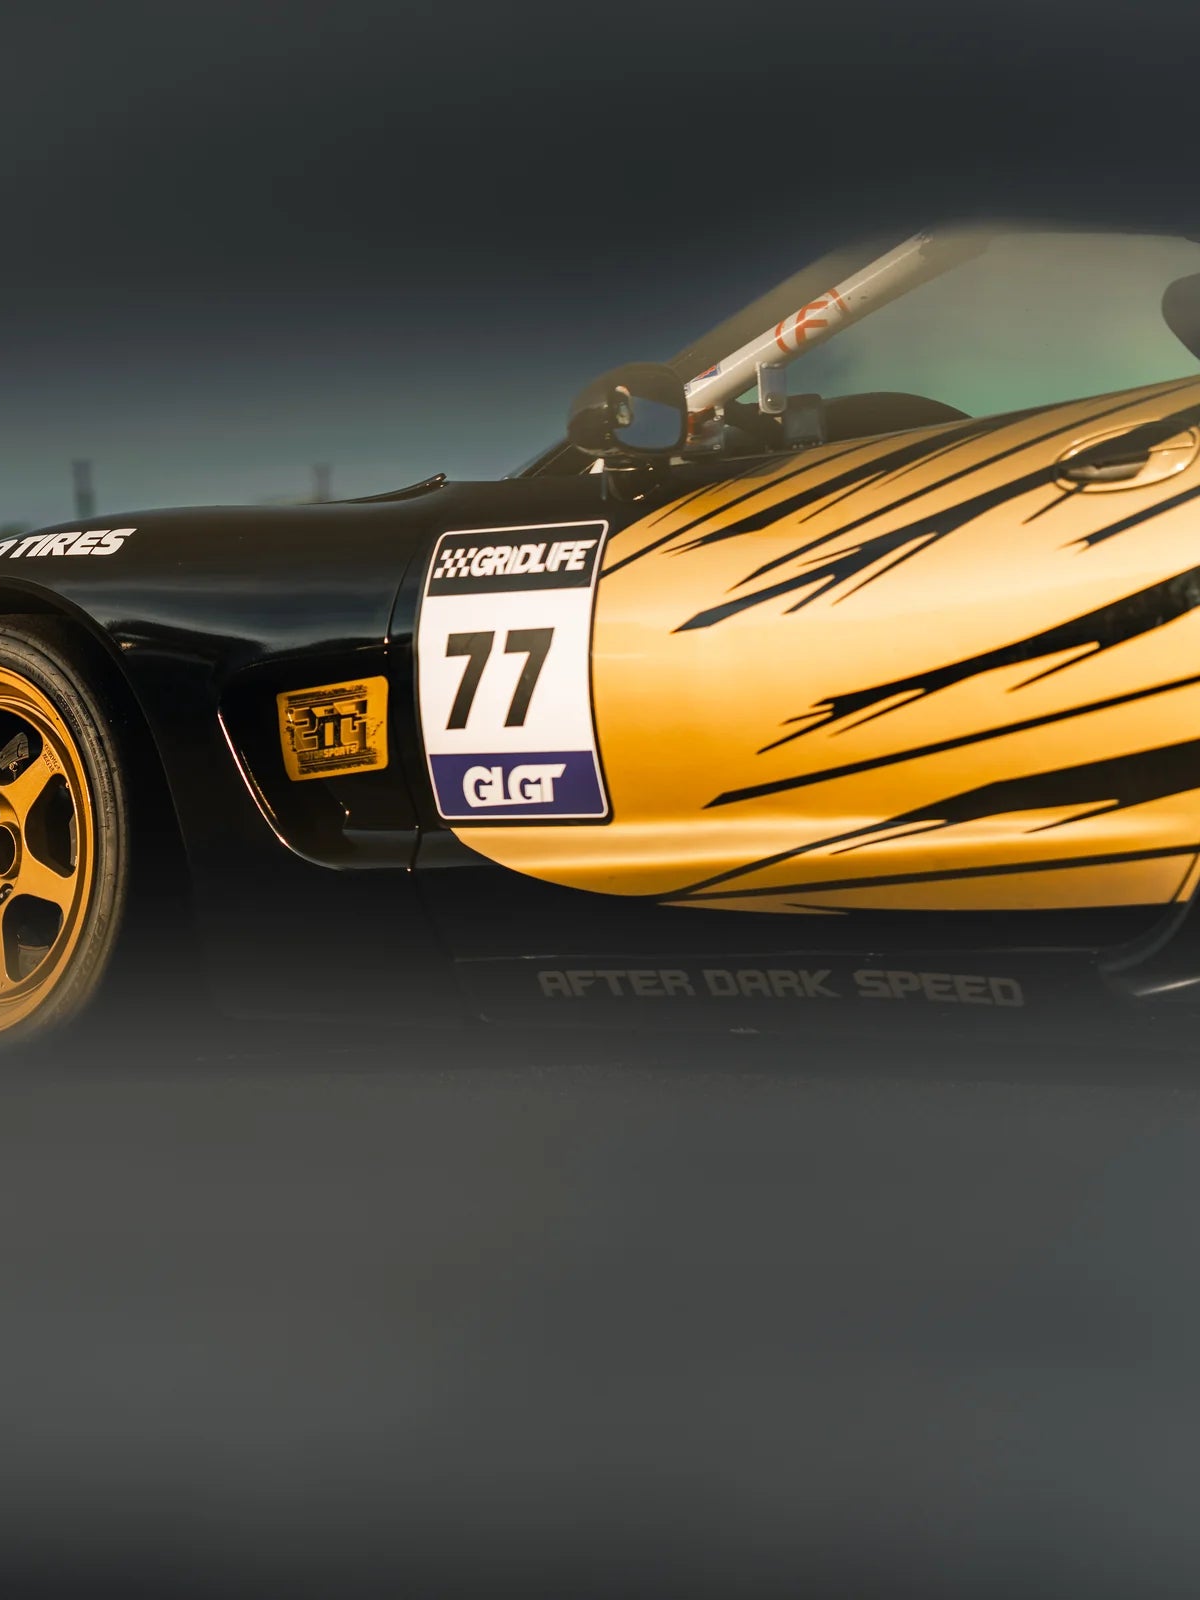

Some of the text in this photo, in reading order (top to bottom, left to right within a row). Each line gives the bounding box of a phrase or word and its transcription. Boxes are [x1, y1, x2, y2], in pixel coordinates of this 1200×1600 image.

[9, 528, 137, 559] TIRES
[470, 539, 598, 577] GRIDLIFE
[445, 627, 555, 730] 77
[462, 763, 567, 808] GLGT
[538, 969, 1025, 1007] AFTER DARK SPEED
